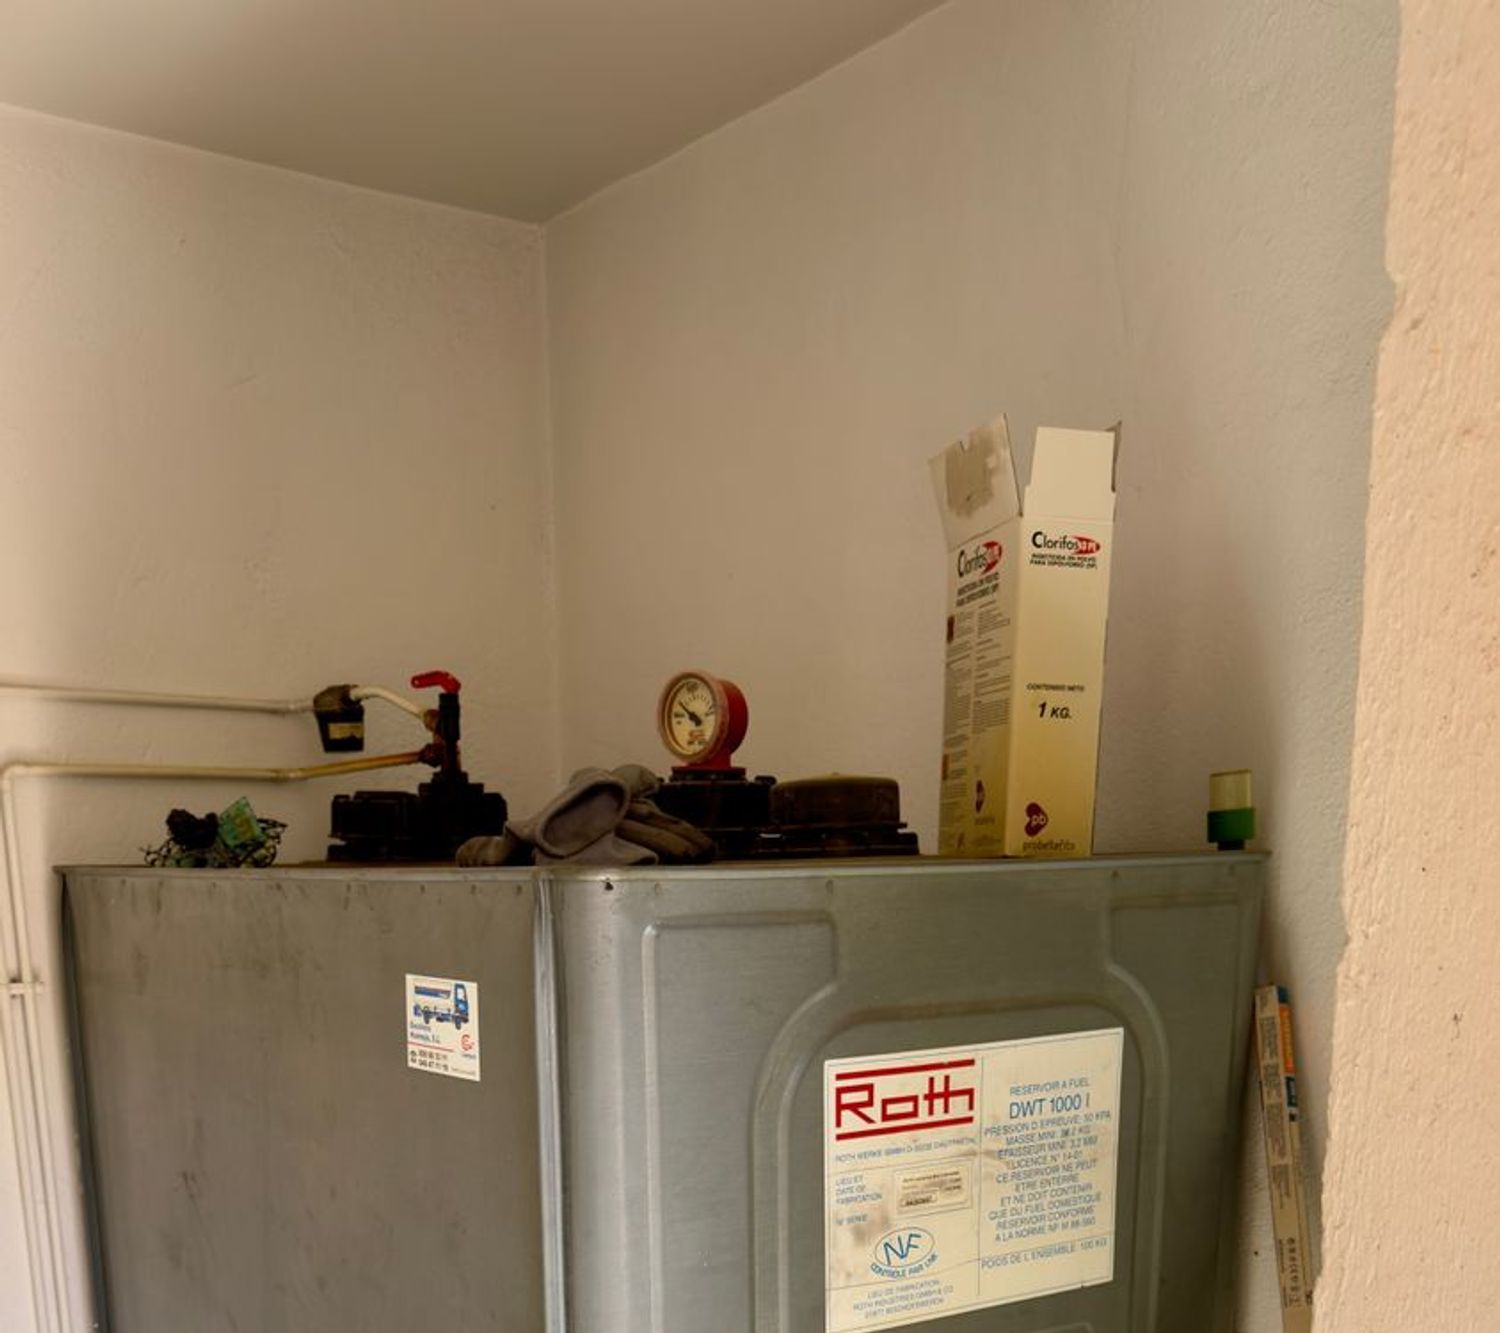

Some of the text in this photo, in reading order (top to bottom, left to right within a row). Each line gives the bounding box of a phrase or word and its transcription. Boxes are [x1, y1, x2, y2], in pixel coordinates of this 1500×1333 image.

[1038, 701, 1047, 718] 1
[835, 1074, 975, 1128] Roth
[1009, 1098, 1046, 1119] DWT
[1049, 1094, 1082, 1113] 1000
[883, 1232, 922, 1265] NF
